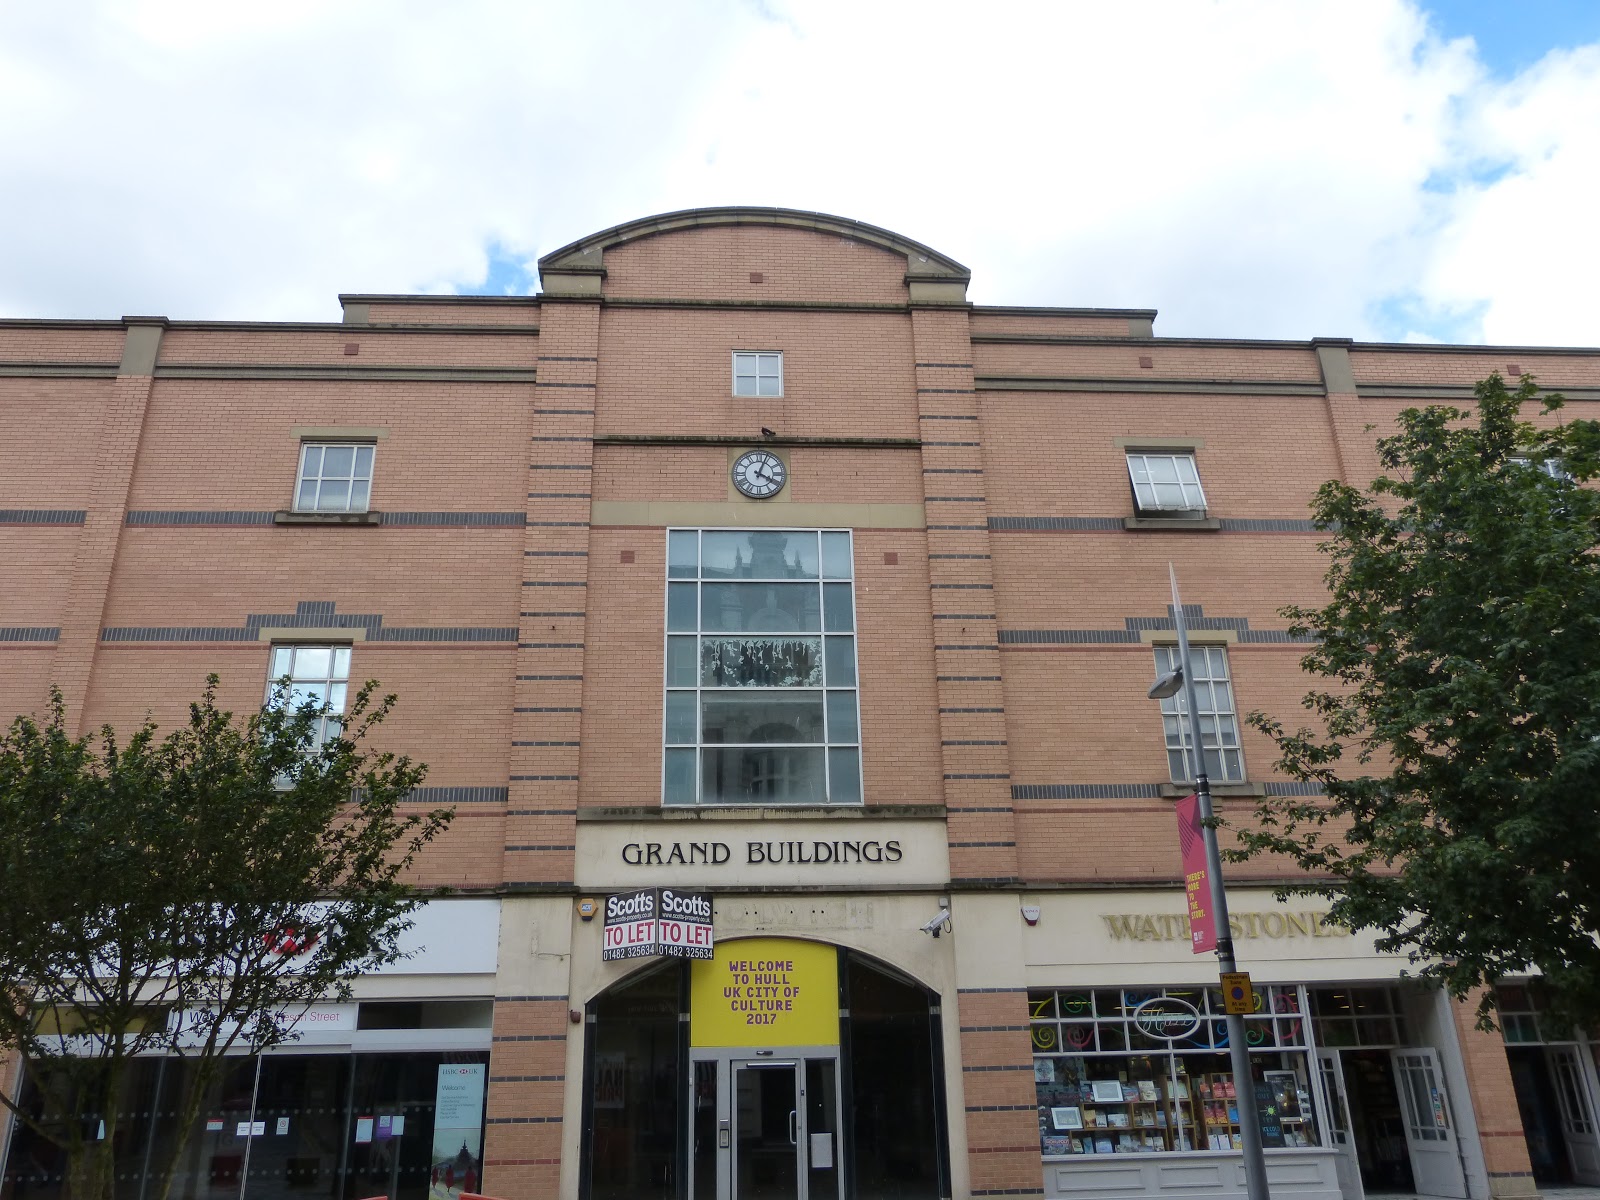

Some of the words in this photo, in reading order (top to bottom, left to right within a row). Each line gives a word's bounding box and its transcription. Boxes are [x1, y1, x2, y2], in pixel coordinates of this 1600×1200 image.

[621, 842, 731, 865] GRAND
[746, 840, 903, 863] BUILDINGS
[1186, 870, 1205, 882] THERE'S
[1187, 882, 1200, 892] MORE
[1188, 893, 1195, 901] TO
[607, 892, 654, 918] Scotts
[661, 890, 711, 917] Scotts
[1190, 901, 1199, 911] THE
[662, 912, 710, 923] www.scotts-property.co.uk
[1191, 909, 1206, 920] STORY.
[605, 926, 623, 947] TO
[628, 921, 655, 943] LET
[660, 922, 681, 943] TO
[686, 925, 711, 945] LET
[603, 948, 625, 961] 01482
[627, 944, 655, 958] 325634
[659, 945, 683, 957] 01482
[685, 948, 713, 959] 325634
[729, 961, 793, 972] WELCOME
[733, 974, 749, 985] TO
[754, 973, 790, 985] HULL
[723, 987, 741, 998] UK
[746, 987, 779, 998] CITY
[783, 986, 800, 998] OF
[731, 1000, 793, 1011] CULTURE
[309, 1011, 340, 1021] Street
[746, 1013, 777, 1025] 2017
